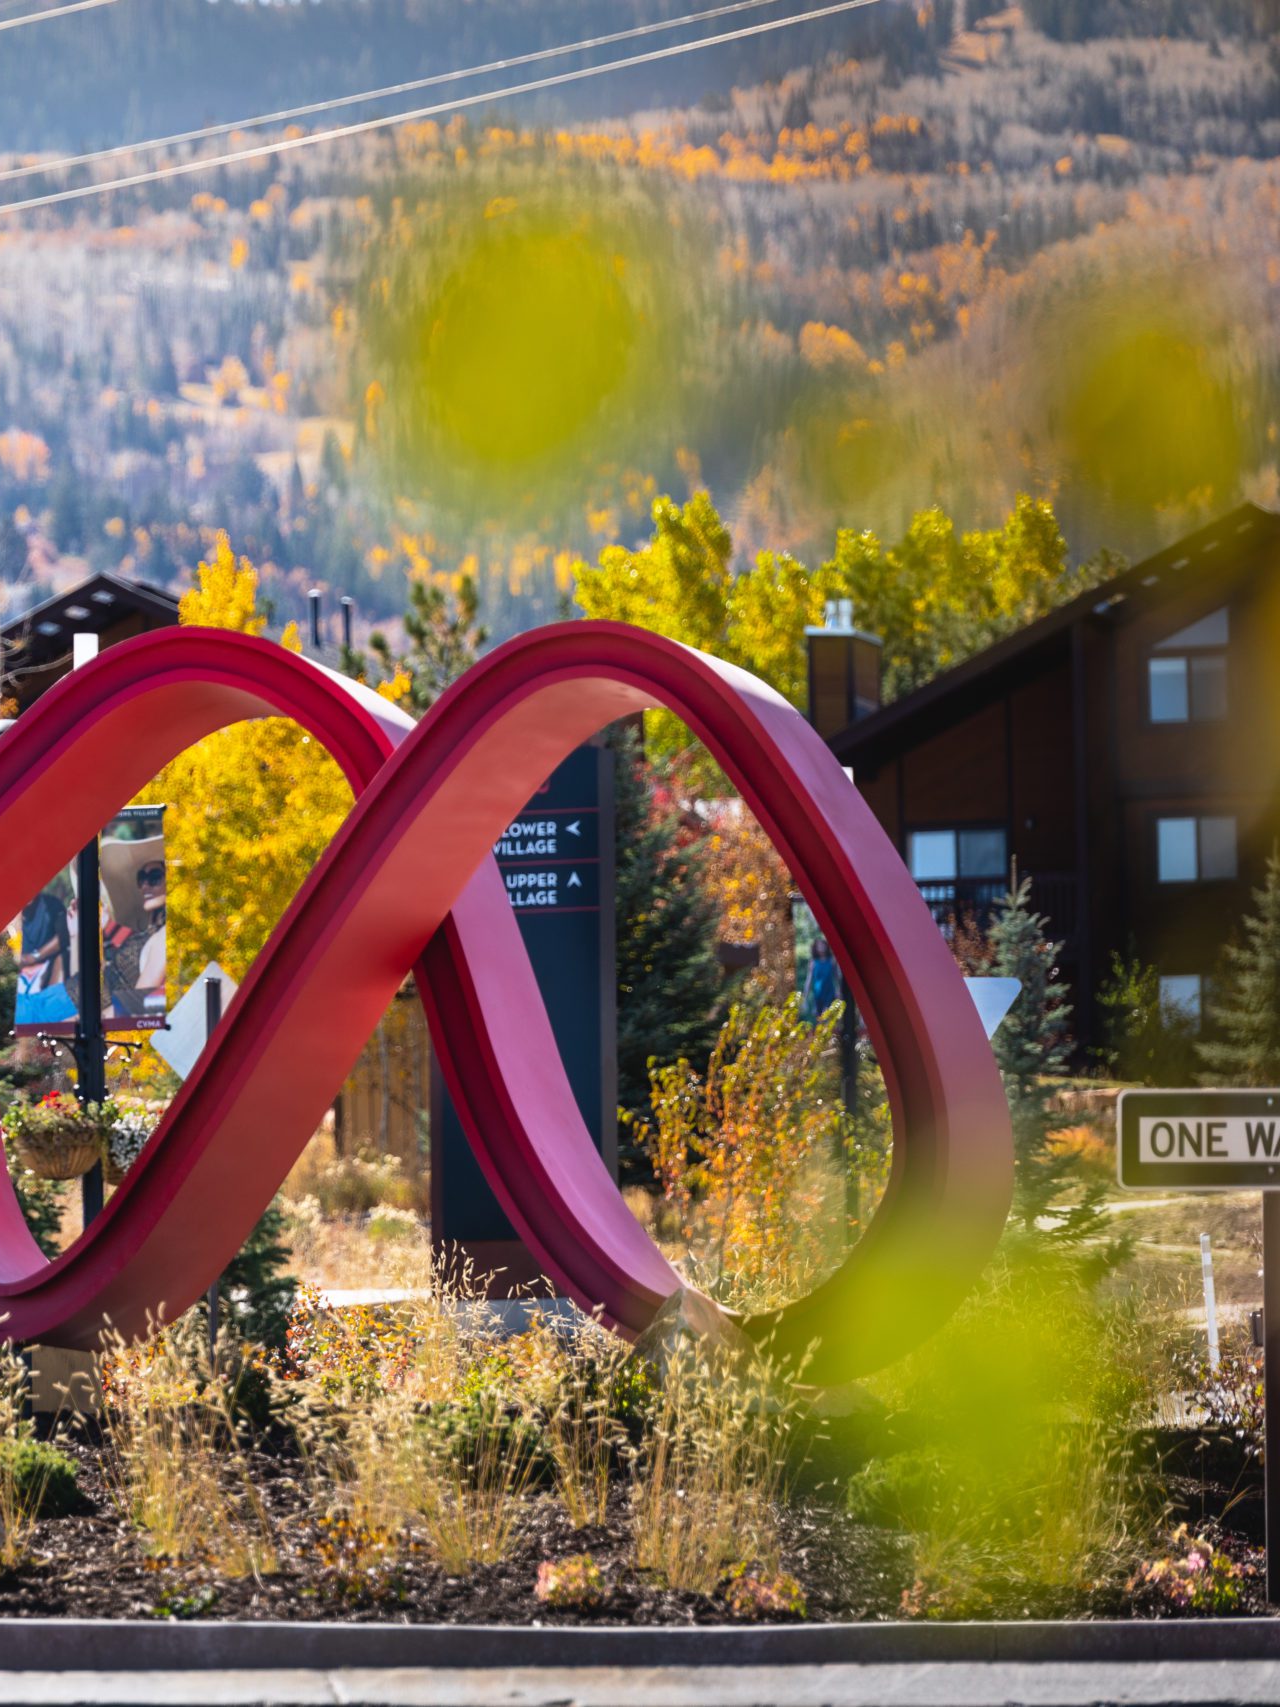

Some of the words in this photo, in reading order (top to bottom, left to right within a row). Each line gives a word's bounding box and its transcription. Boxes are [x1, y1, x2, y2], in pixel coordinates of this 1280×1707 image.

[493, 839, 557, 855] VILLAGE
[506, 872, 558, 889] UPPER
[507, 890, 558, 906] LLAGE
[1150, 1121, 1229, 1158] ONE
